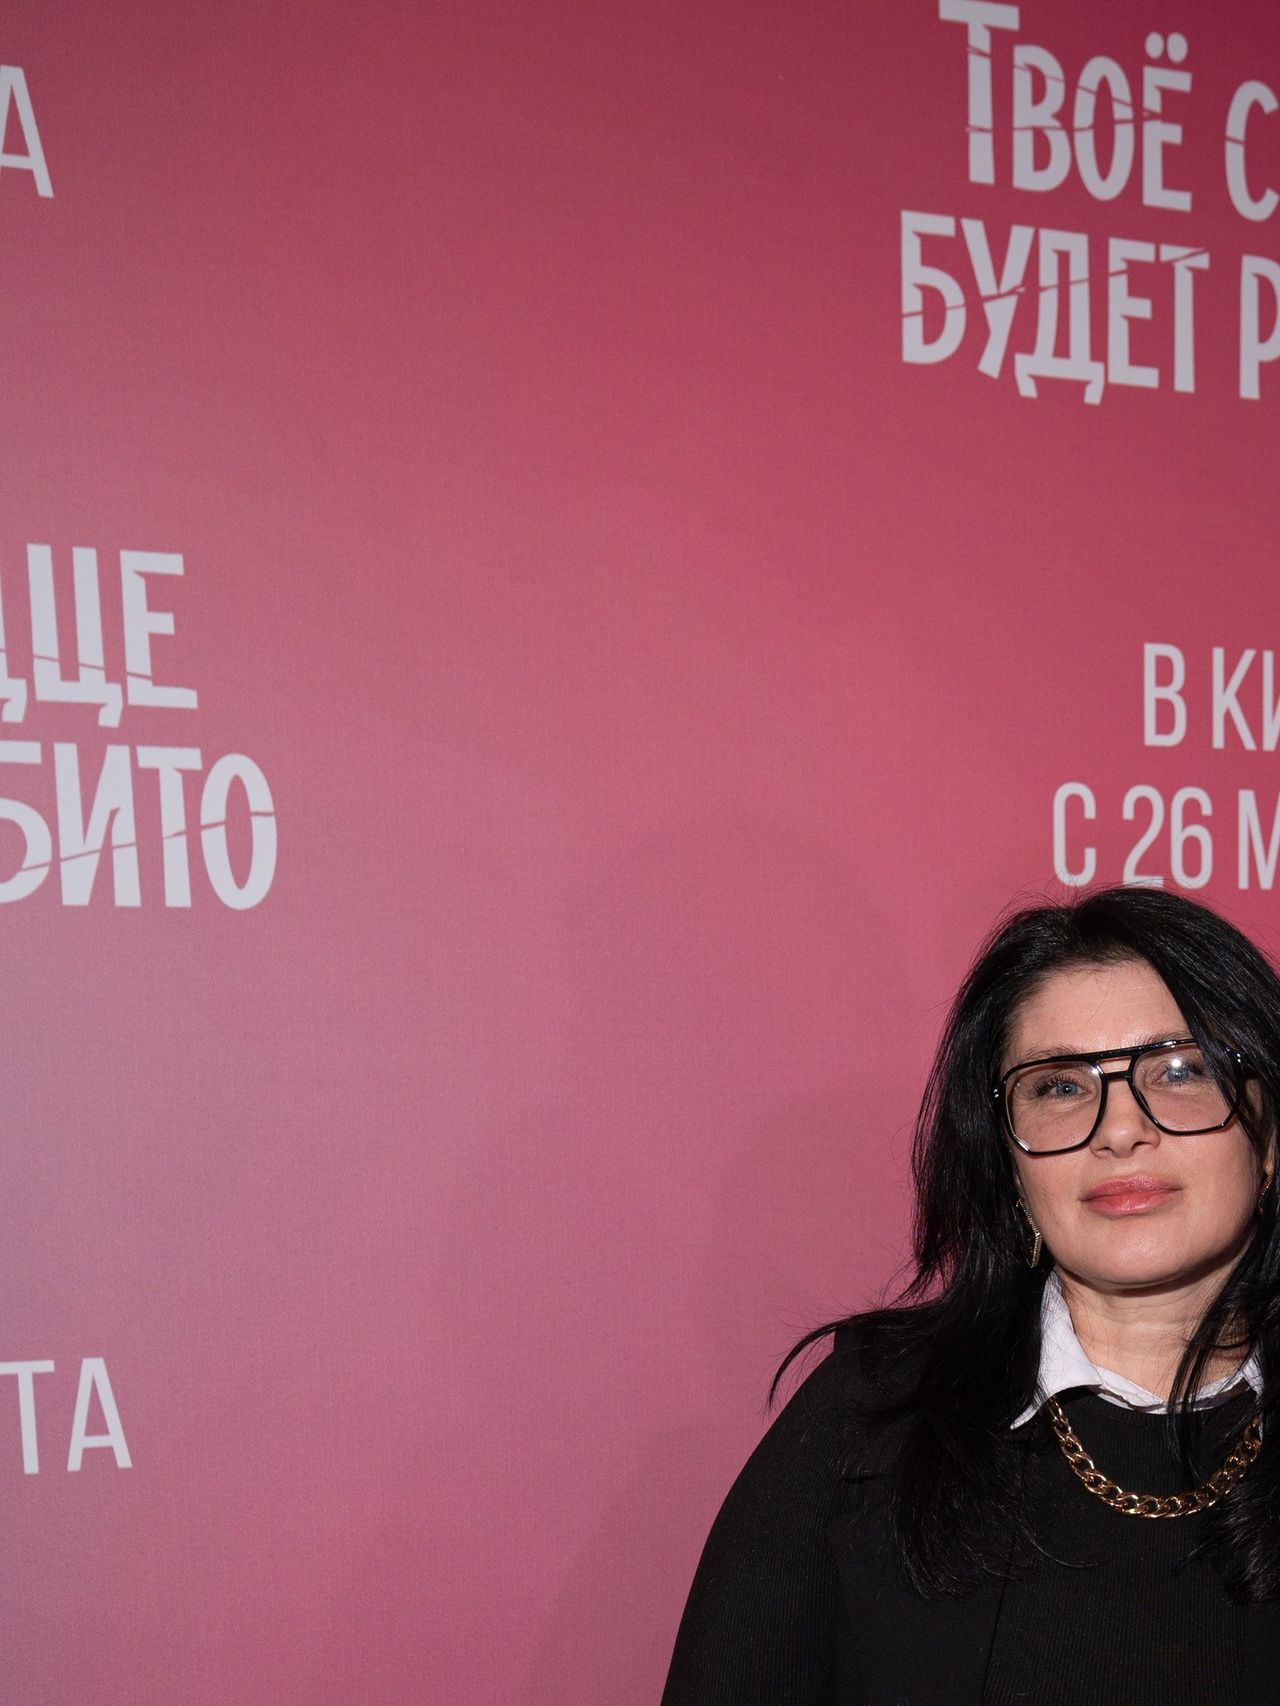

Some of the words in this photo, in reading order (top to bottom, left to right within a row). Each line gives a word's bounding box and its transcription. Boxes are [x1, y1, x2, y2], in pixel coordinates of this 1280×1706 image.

[938, 0, 1192, 212] ТВОЁ
[900, 210, 1210, 405] БУДЕТ
[0, 543, 198, 728] ЦЕ
[1143, 642, 1187, 747] В
[1053, 782, 1096, 887] С
[1122, 785, 1213, 890] 26
